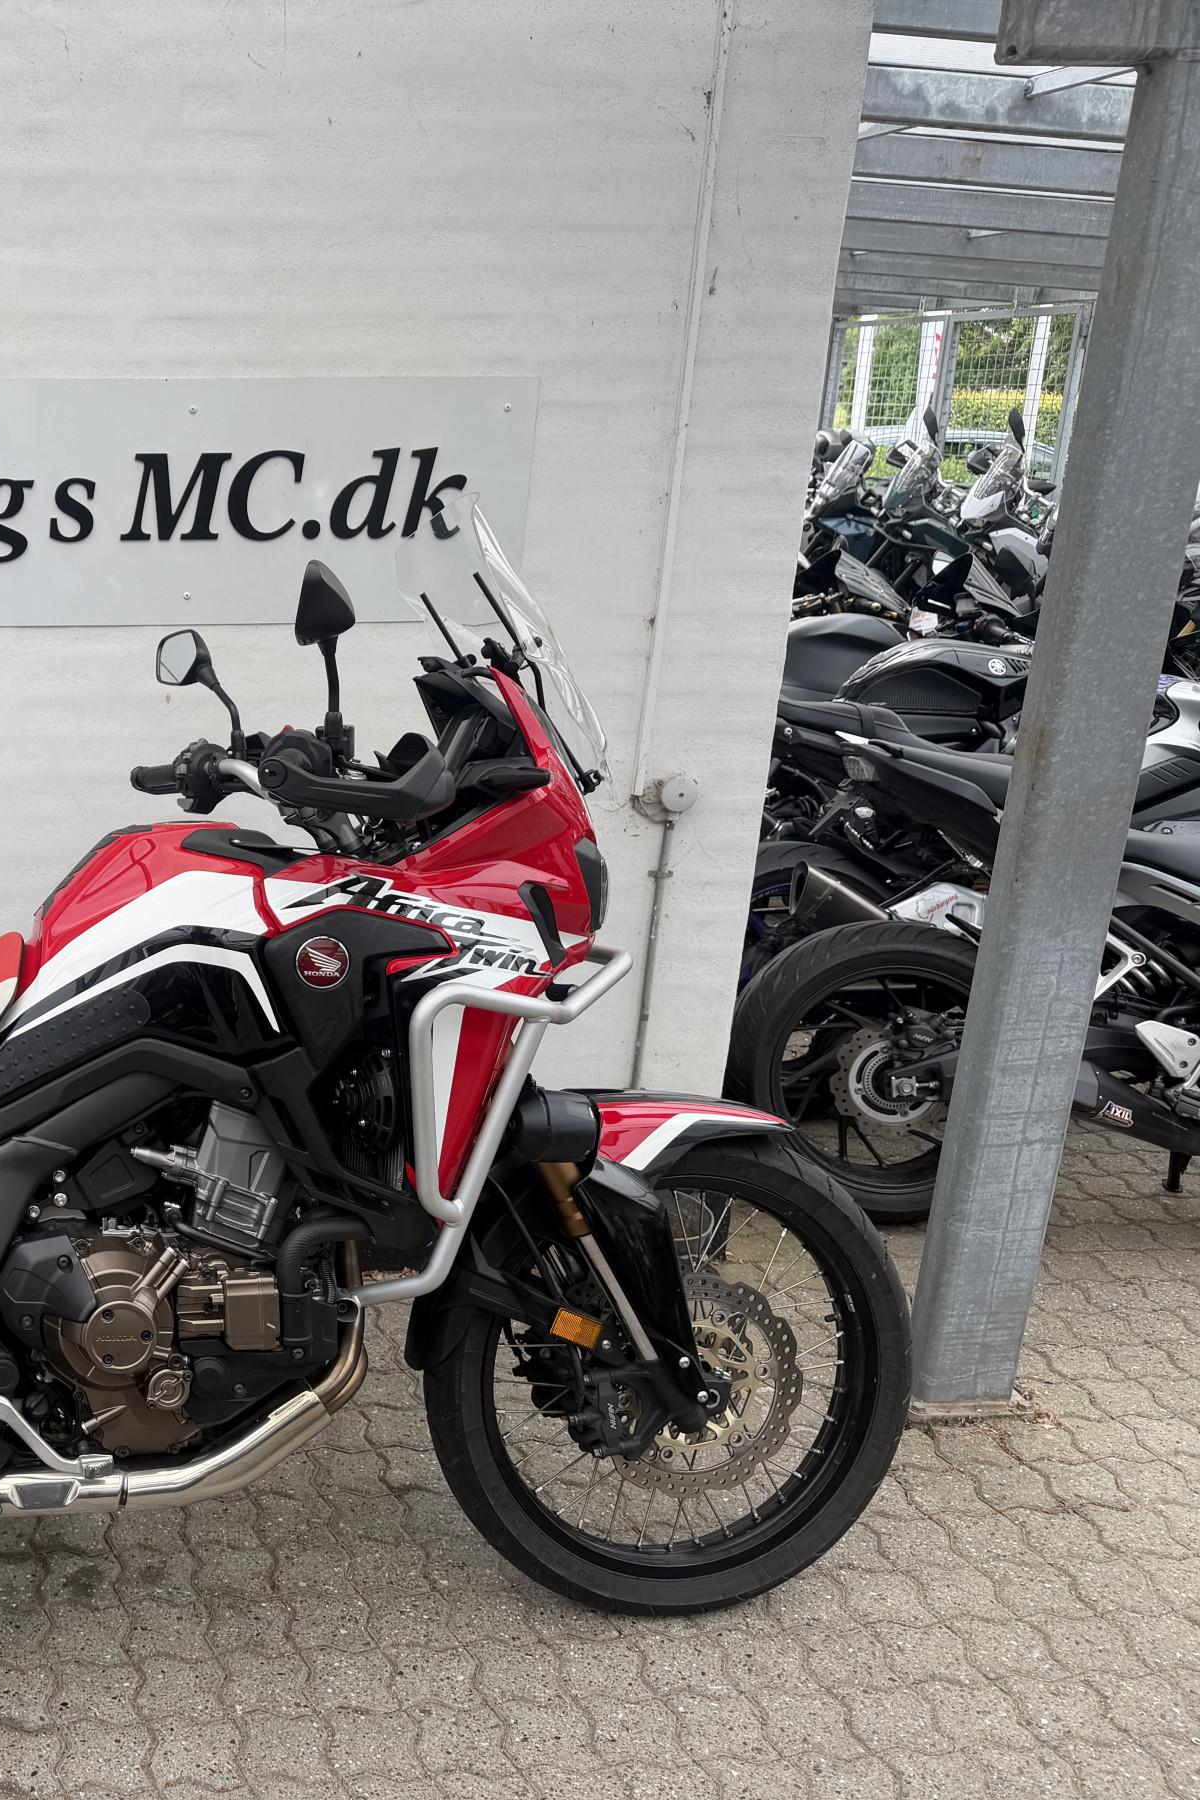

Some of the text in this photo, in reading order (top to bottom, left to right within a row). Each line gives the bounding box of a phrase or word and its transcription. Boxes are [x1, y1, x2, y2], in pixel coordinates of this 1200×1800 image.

[119, 446, 468, 542] MC.dk
[281, 872, 522, 943] Africa
[303, 970, 341, 978] HONDA
[403, 934, 552, 982] Twin
[1109, 1105, 1131, 1121] IXIL
